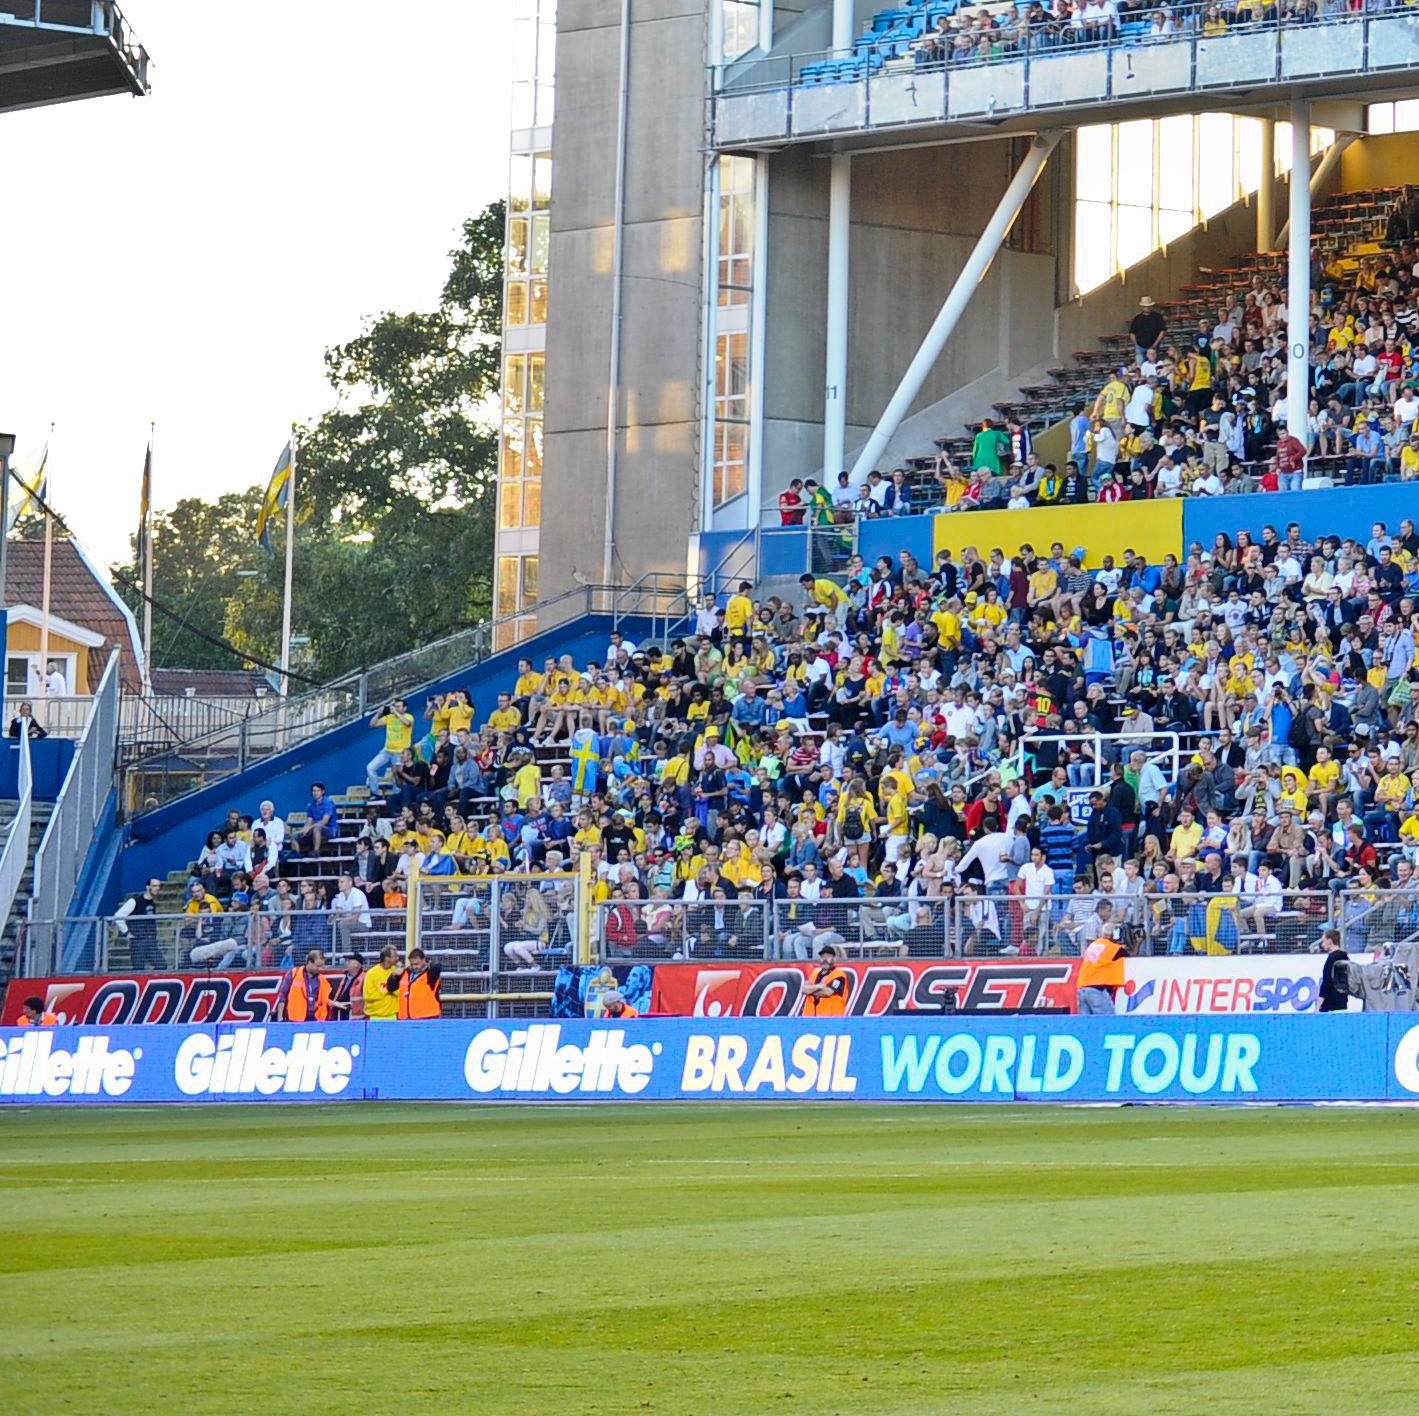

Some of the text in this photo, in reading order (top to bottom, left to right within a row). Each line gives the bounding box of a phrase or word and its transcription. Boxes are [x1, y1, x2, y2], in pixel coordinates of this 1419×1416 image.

[826, 384, 837, 400] 11
[1036, 697, 1051, 712] 10
[0, 1032, 135, 1095] illette
[175, 1028, 352, 1095] Gillette
[464, 1024, 1261, 1094] Gillette BRASIL WORLD TOUR
